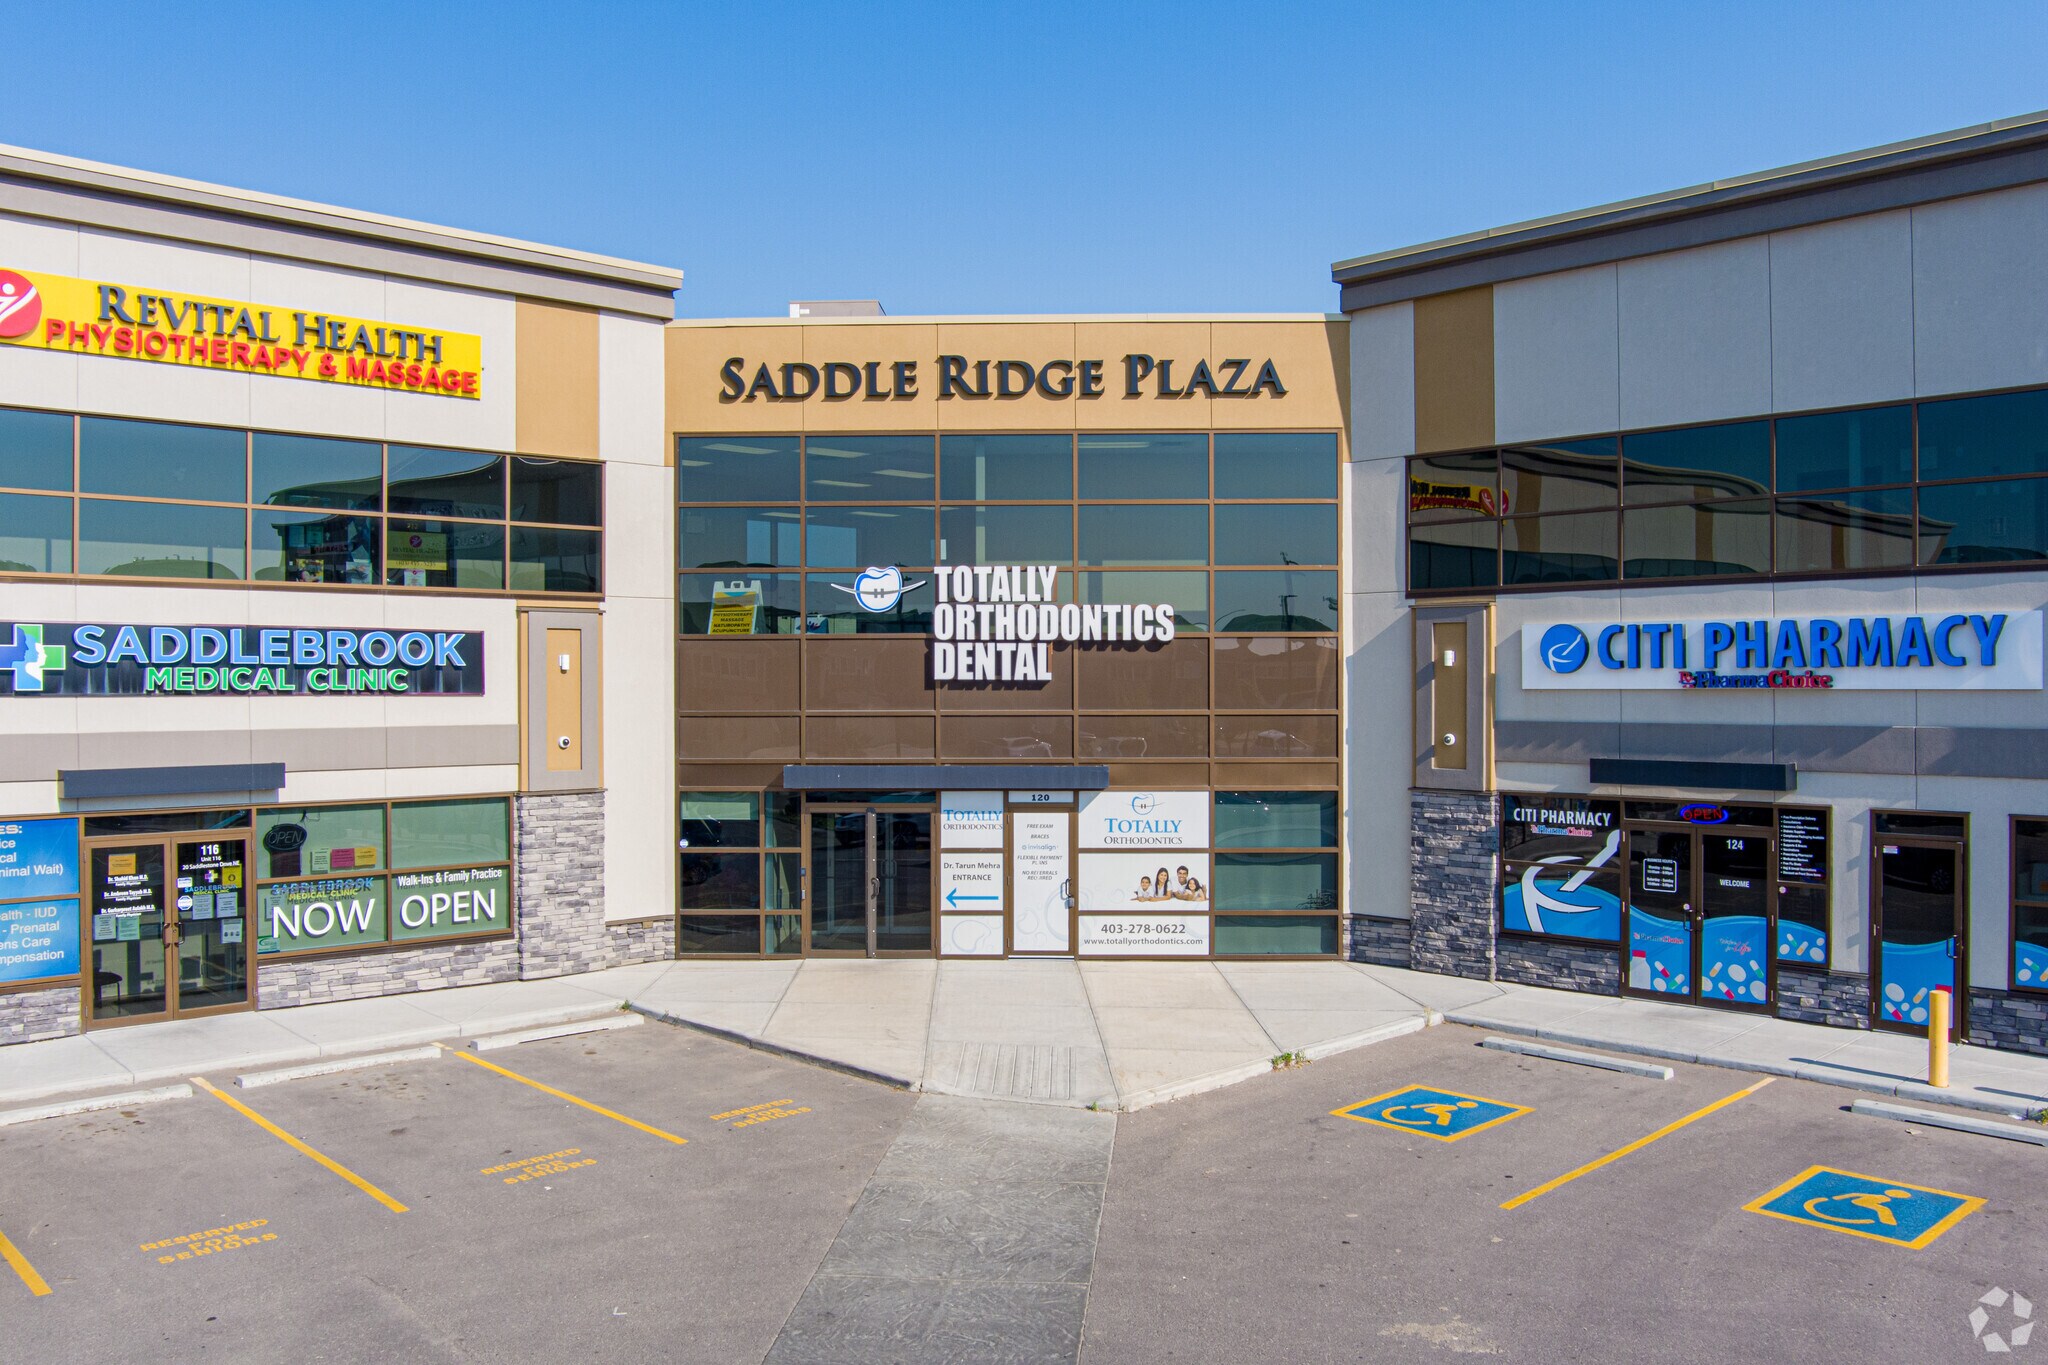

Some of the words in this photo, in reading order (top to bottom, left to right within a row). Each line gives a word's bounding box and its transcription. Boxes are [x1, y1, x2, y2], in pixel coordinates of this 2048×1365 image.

[97, 284, 280, 341] REVITAL
[293, 311, 444, 364] HEALTH
[45, 317, 311, 373] PHYSIOTHERAPY
[319, 353, 338, 378] &
[346, 356, 477, 393] MASSAGE
[720, 357, 918, 400] SADDLE
[936, 355, 1106, 399] RIDGE
[1124, 354, 1289, 399] PLAZA
[934, 566, 1057, 602] TOTALLY
[934, 604, 1175, 642] ORTHODONTICS
[72, 624, 467, 668] SADDLEBROOK
[1598, 624, 1687, 670] CITI
[1704, 614, 2008, 670] PHARMACY
[934, 642, 1052, 680] DENTAL
[146, 666, 296, 691] MEDICAL
[308, 667, 409, 692] CLINIC
[944, 810, 1002, 822] TOTALLY
[1513, 808, 1536, 822] CITI
[1541, 810, 1611, 826] PHARMACY
[1682, 808, 1722, 820] OPEN
[1104, 818, 1182, 833] TOTALLY
[268, 830, 303, 844] OPEN
[1104, 836, 1182, 844] ORTHODONTICS
[1726, 839, 1744, 850] 124
[200, 844, 220, 856] 116
[34, 863, 64, 876] Wait)
[398, 874, 434, 886] Walk-Ins
[436, 872, 442, 884] &
[444, 870, 470, 882] Family
[472, 868, 502, 880] Practice
[272, 878, 374, 894] SADDLEBROOK
[1720, 879, 1750, 888] WELCOME
[288, 890, 327, 900] MEDICAL
[330, 888, 358, 897] CLINIC
[34, 906, 57, 918] IUD
[401, 888, 496, 928] OPEN
[10, 921, 60, 934] Prenatal
[272, 899, 376, 939] NOW
[1101, 924, 1186, 934] 403-278-0622
[22, 937, 50, 948] Care
[1084, 937, 1203, 946] www.totallyorthodontics.com
[710, 1099, 793, 1120] RESERVED
[733, 1106, 812, 1128] SENIORS
[746, 1108, 784, 1118] FOR
[480, 1148, 582, 1175] RESERVED
[522, 1160, 566, 1173] FOR
[504, 1158, 598, 1184] SENIORS
[139, 1218, 268, 1252] RESERVED
[188, 1234, 241, 1251] FOR
[158, 1232, 278, 1264] SENIORS
